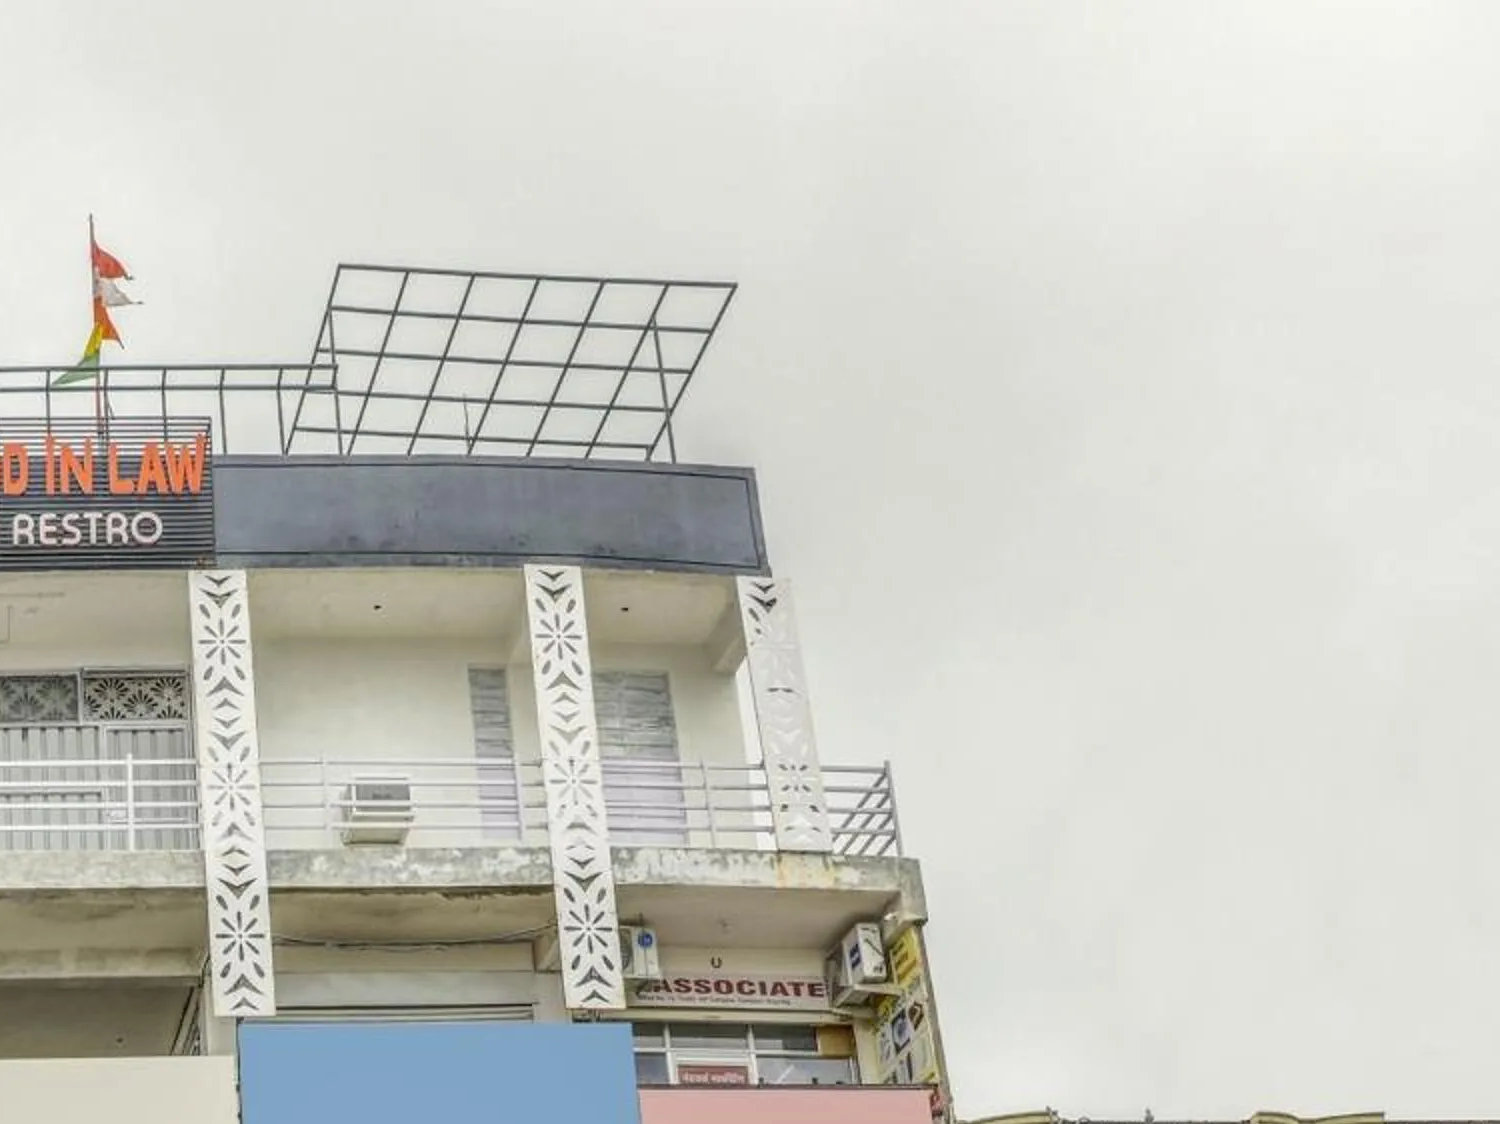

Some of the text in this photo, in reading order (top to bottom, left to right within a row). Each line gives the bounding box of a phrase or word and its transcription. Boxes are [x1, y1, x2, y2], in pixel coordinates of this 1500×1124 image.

[45, 432, 93, 496] IN
[108, 430, 209, 496] LAW
[13, 511, 163, 546] RESTRO
